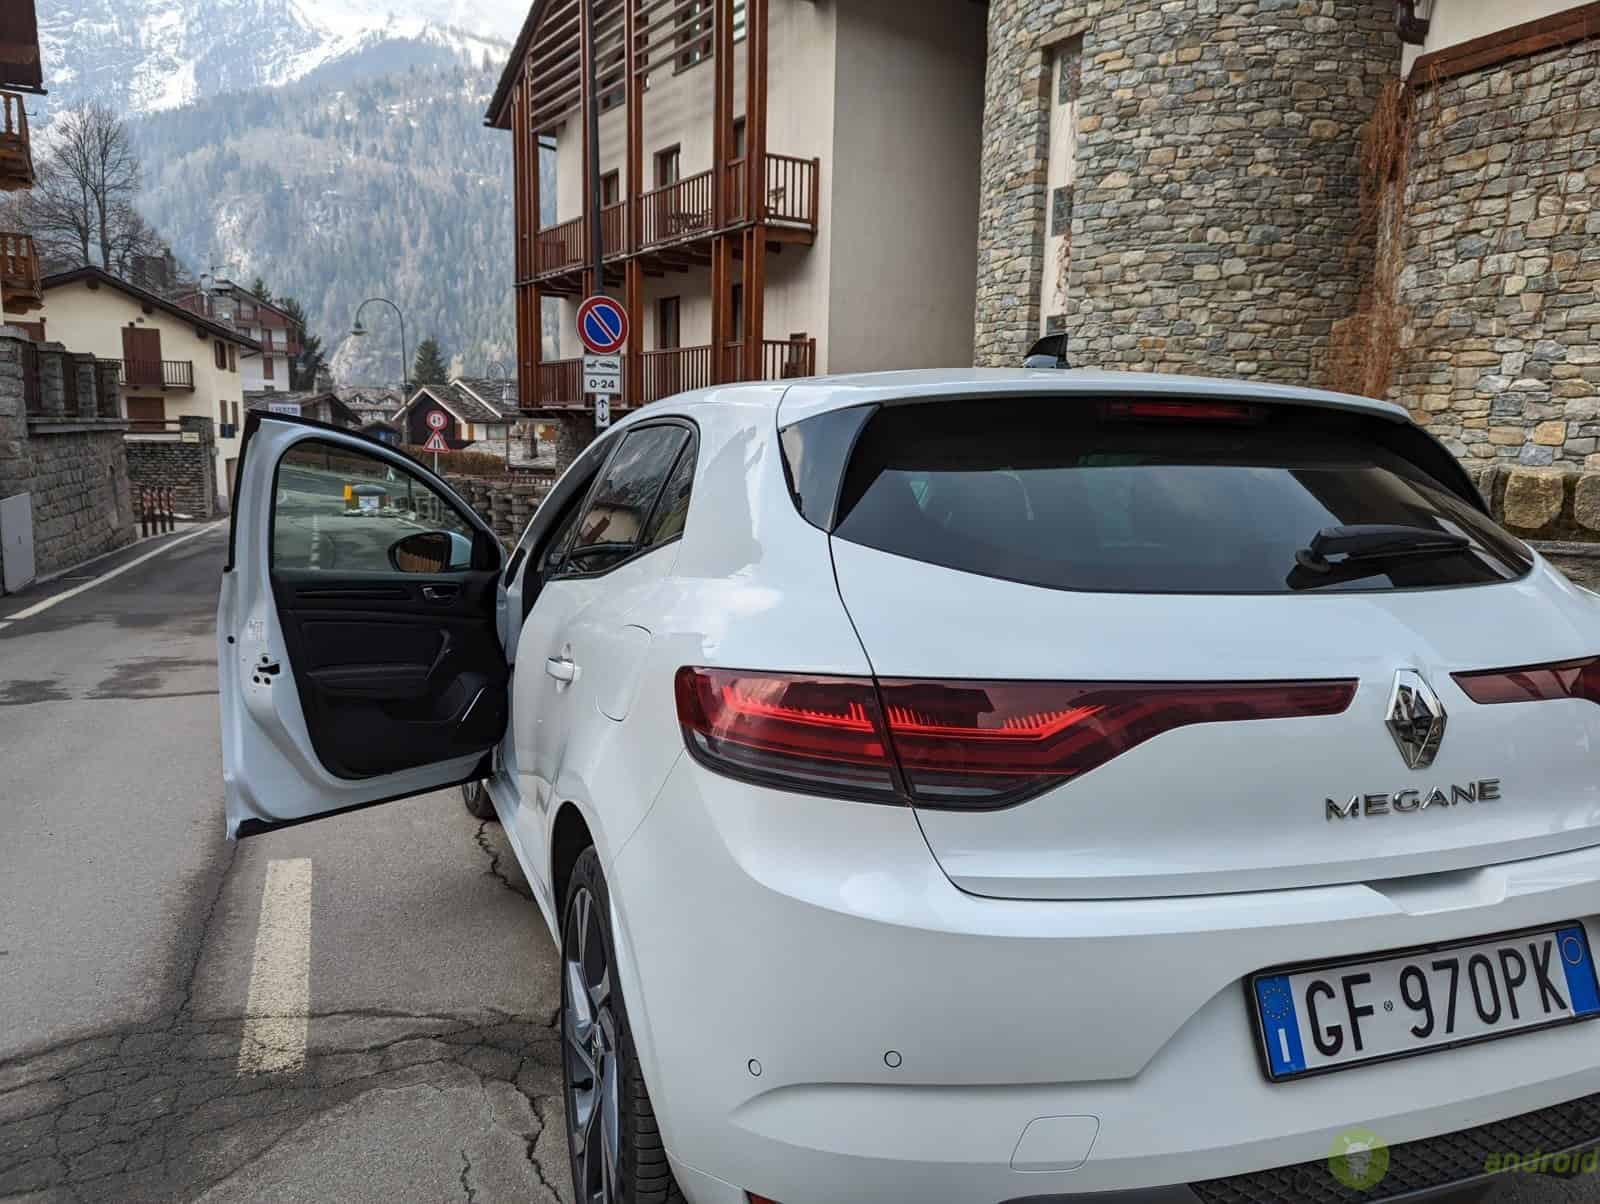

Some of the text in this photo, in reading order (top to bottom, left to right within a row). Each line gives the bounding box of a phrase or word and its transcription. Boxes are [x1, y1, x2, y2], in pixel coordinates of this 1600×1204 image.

[589, 379, 615, 389] 0-24
[1325, 777, 1502, 822] MEGANE
[1305, 939, 1568, 1057] GF 970PK
